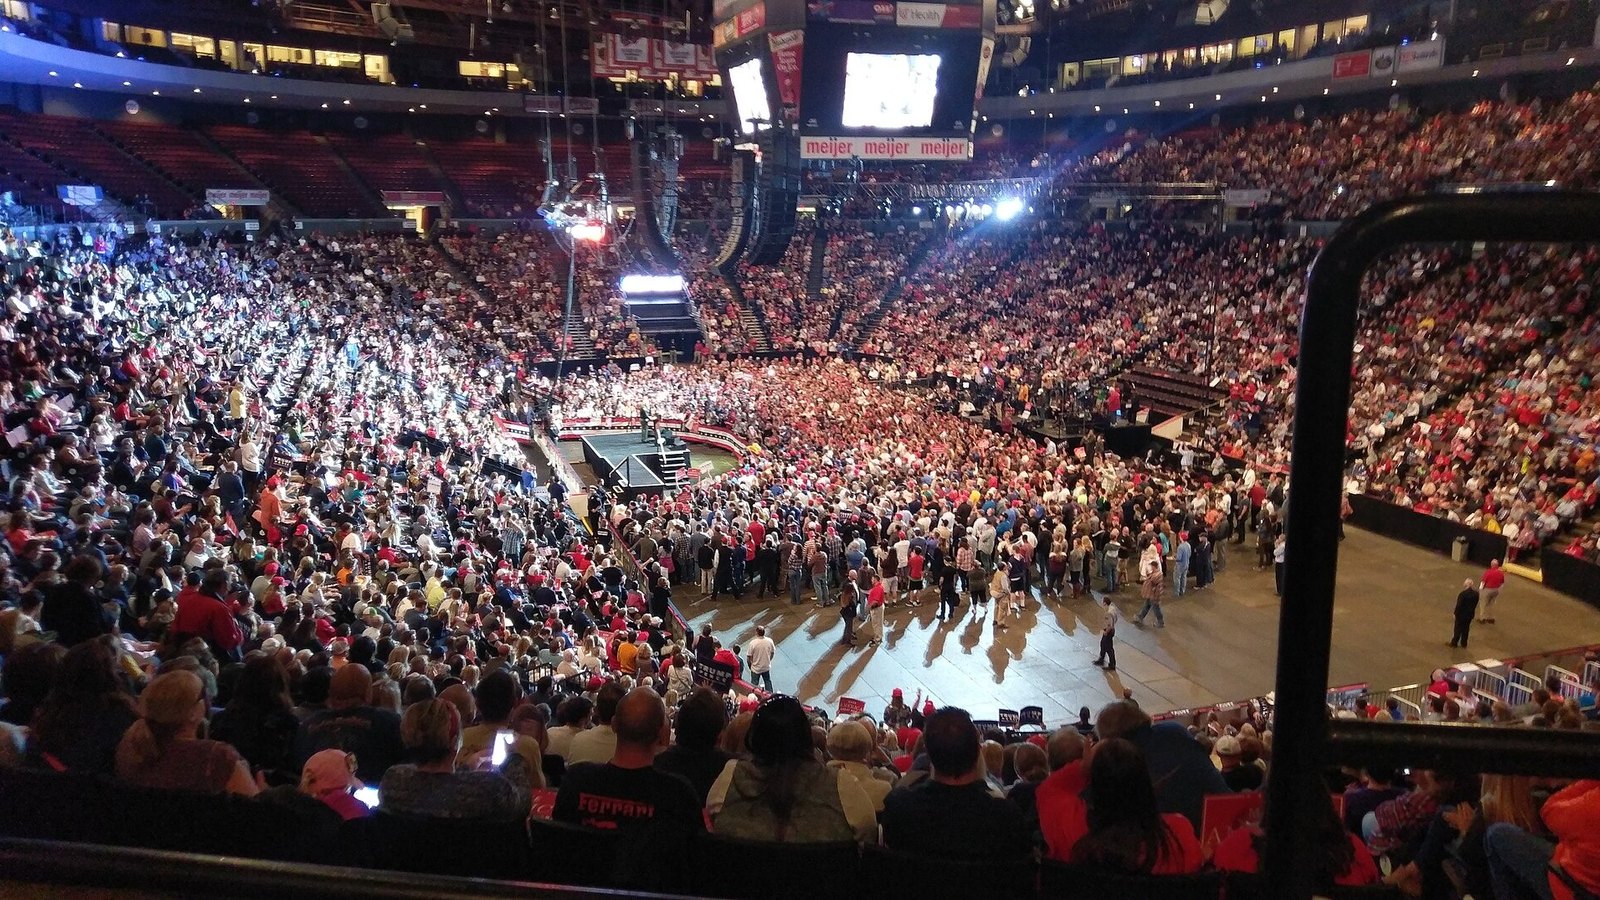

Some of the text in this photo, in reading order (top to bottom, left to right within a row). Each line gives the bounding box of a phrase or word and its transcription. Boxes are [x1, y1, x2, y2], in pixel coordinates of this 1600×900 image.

[910, 8, 940, 20] Health
[806, 136, 965, 158] meijer meijer meijer
[699, 663, 732, 678] TRUMP
[578, 791, 655, 818] Ferrari
